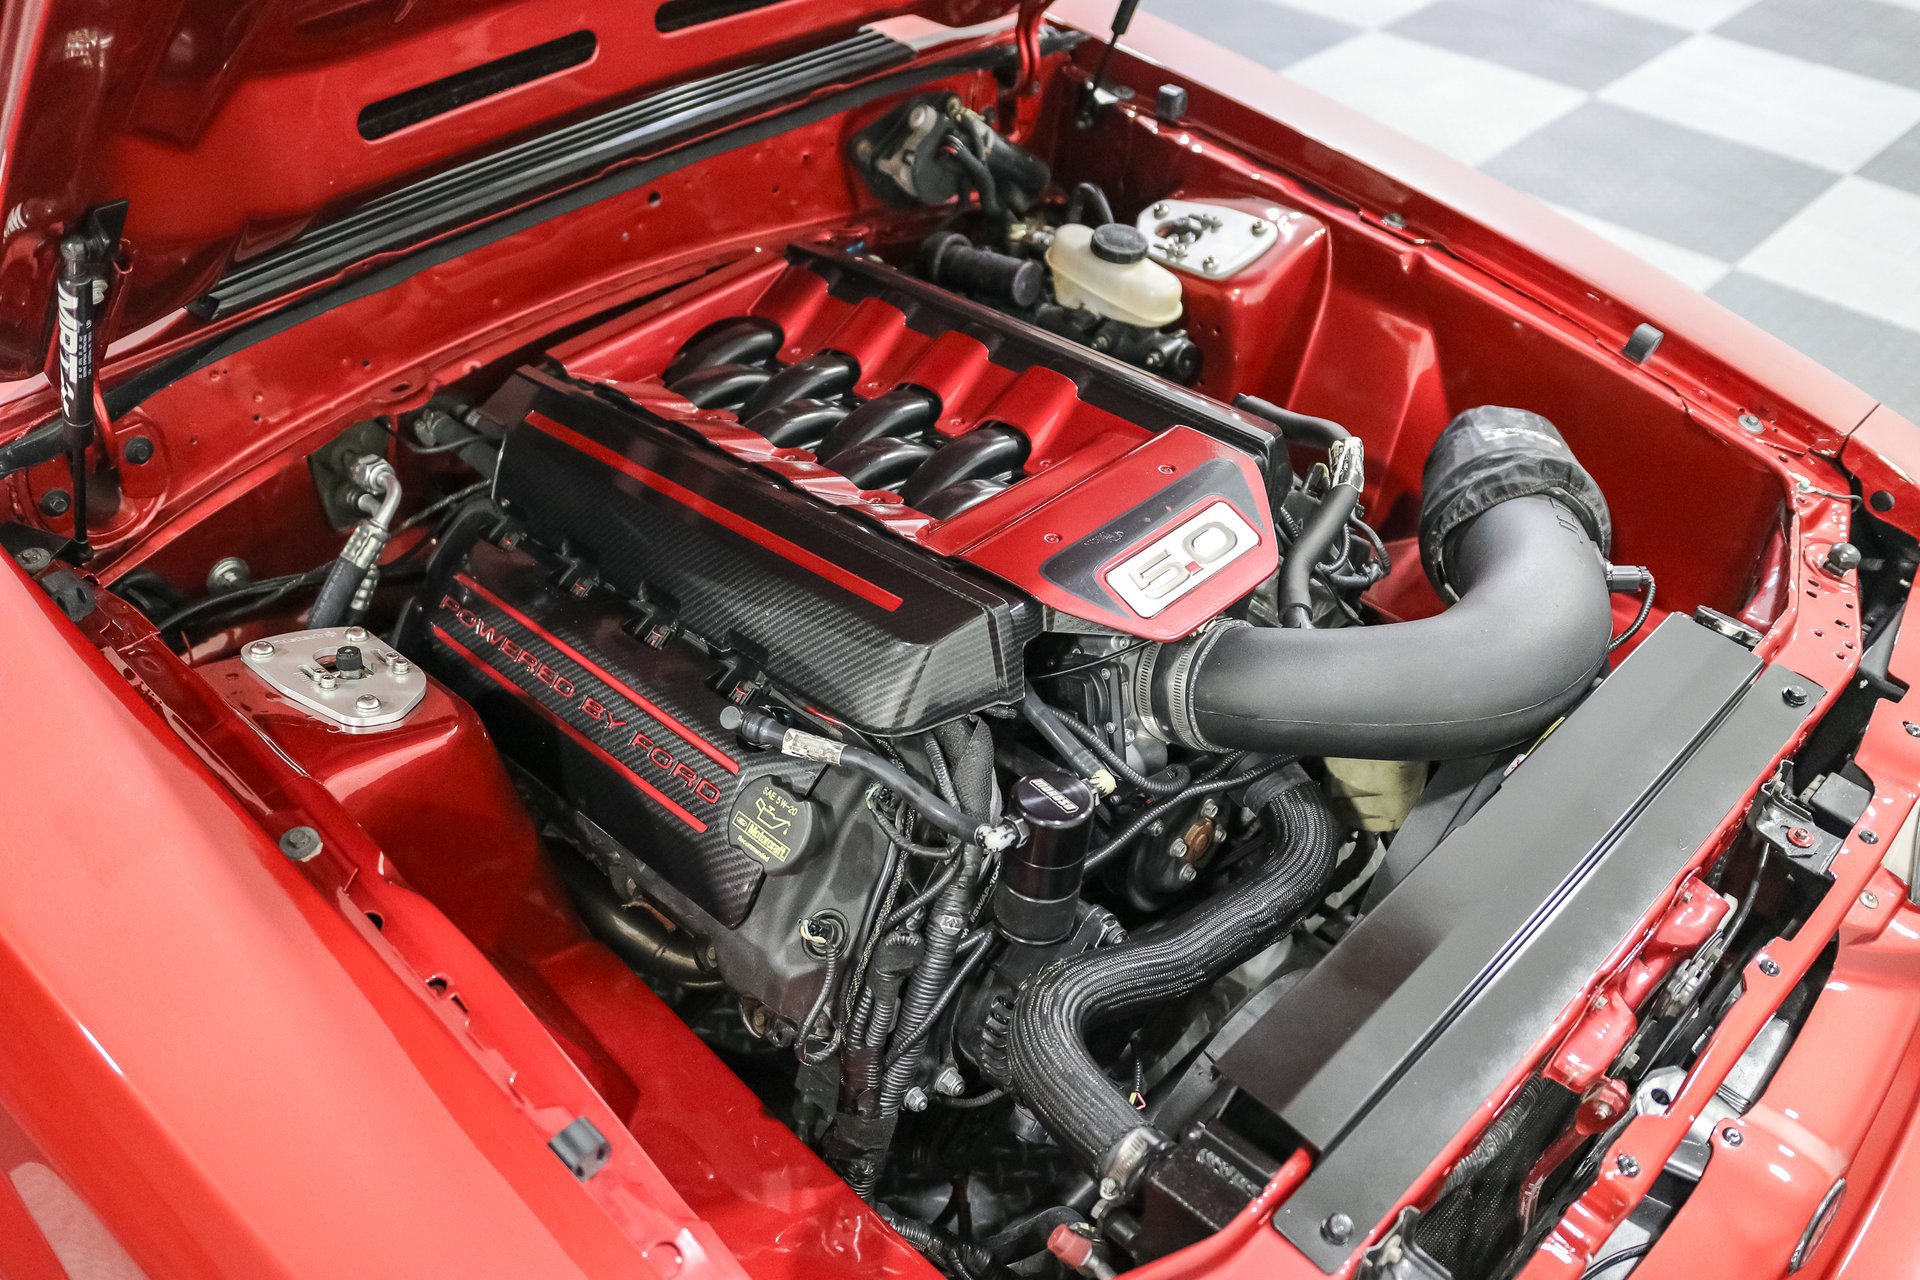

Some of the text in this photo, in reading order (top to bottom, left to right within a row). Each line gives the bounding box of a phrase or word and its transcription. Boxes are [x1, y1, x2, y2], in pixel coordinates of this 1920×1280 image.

[1128, 521, 1239, 600] 5.0
[439, 594, 575, 698] POWERED
[579, 695, 628, 729] BY
[628, 732, 721, 804] FORD
[762, 786, 799, 816] SAE 5W-20
[737, 834, 771, 863] Recommended
[747, 823, 787, 858] Motorcraft
